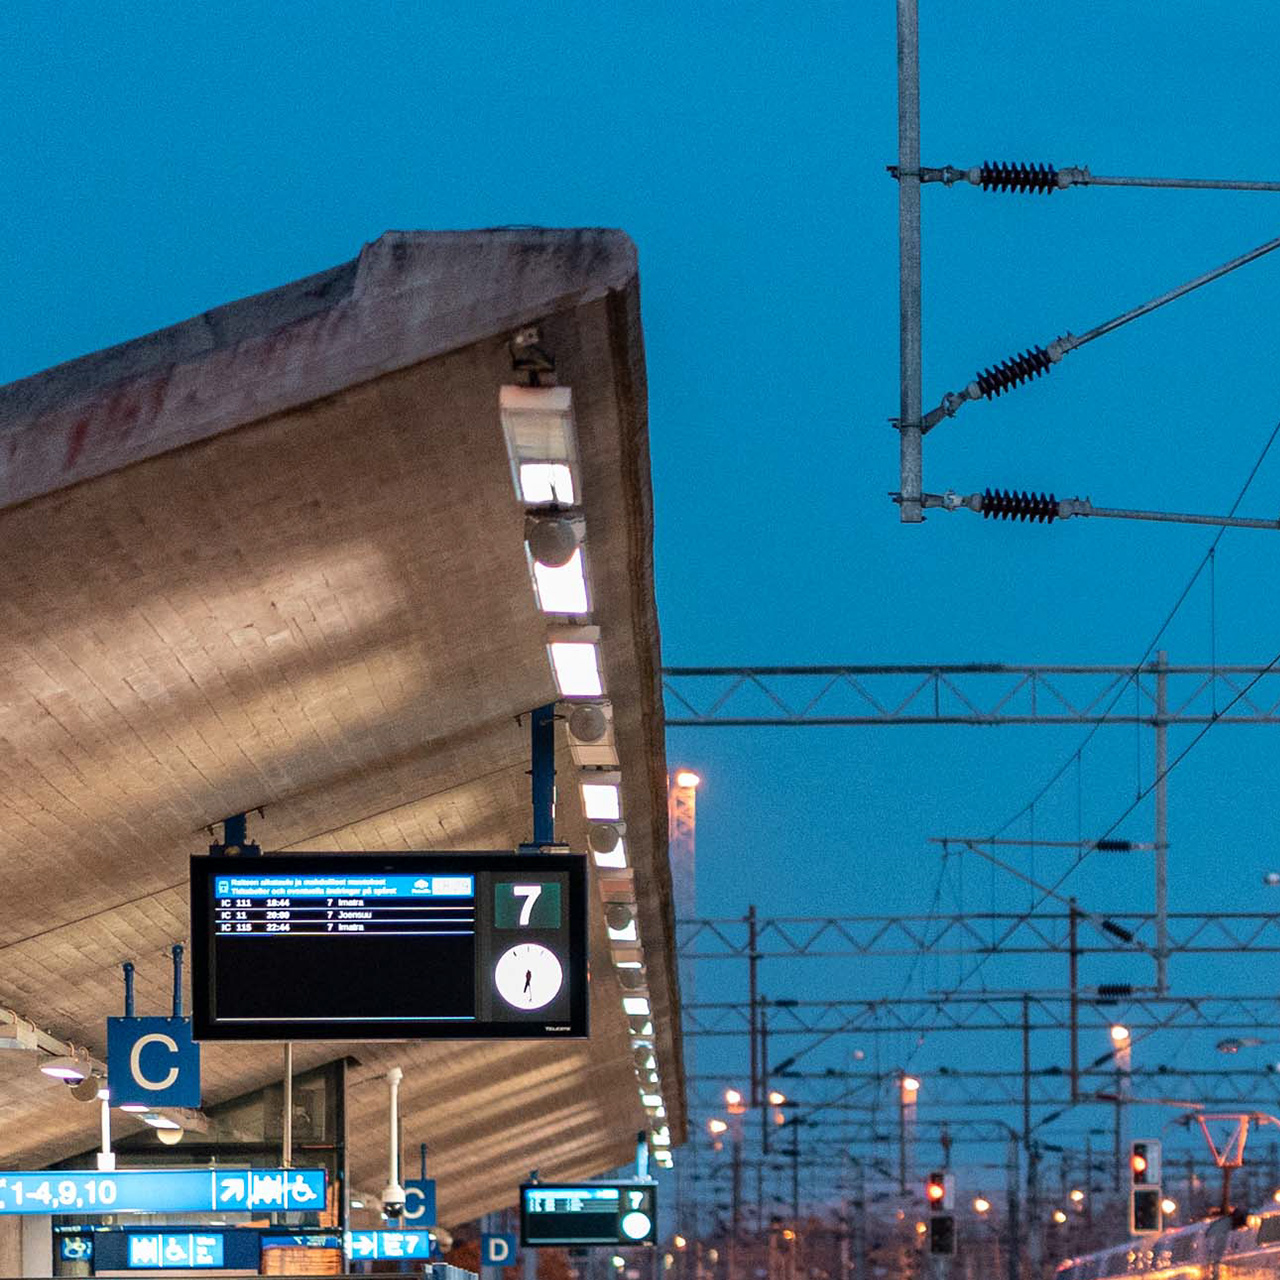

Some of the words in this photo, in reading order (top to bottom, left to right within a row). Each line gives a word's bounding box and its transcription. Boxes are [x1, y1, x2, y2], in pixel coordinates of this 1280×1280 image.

[221, 899, 231, 907] IC
[236, 899, 252, 907] 111
[327, 899, 333, 907] 7
[514, 886, 541, 925] 7
[221, 911, 231, 919] IC
[236, 911, 247, 919] 11
[327, 911, 333, 919] 7
[221, 923, 231, 931] IC
[236, 923, 252, 931] 115
[327, 923, 333, 931] 7
[131, 1033, 179, 1091] C
[10, 1179, 118, 1209] 1-4,9,10
[403, 1187, 426, 1219] C
[629, 1190, 643, 1210] 7
[404, 1235, 420, 1255] 7
[489, 1237, 509, 1261] D
